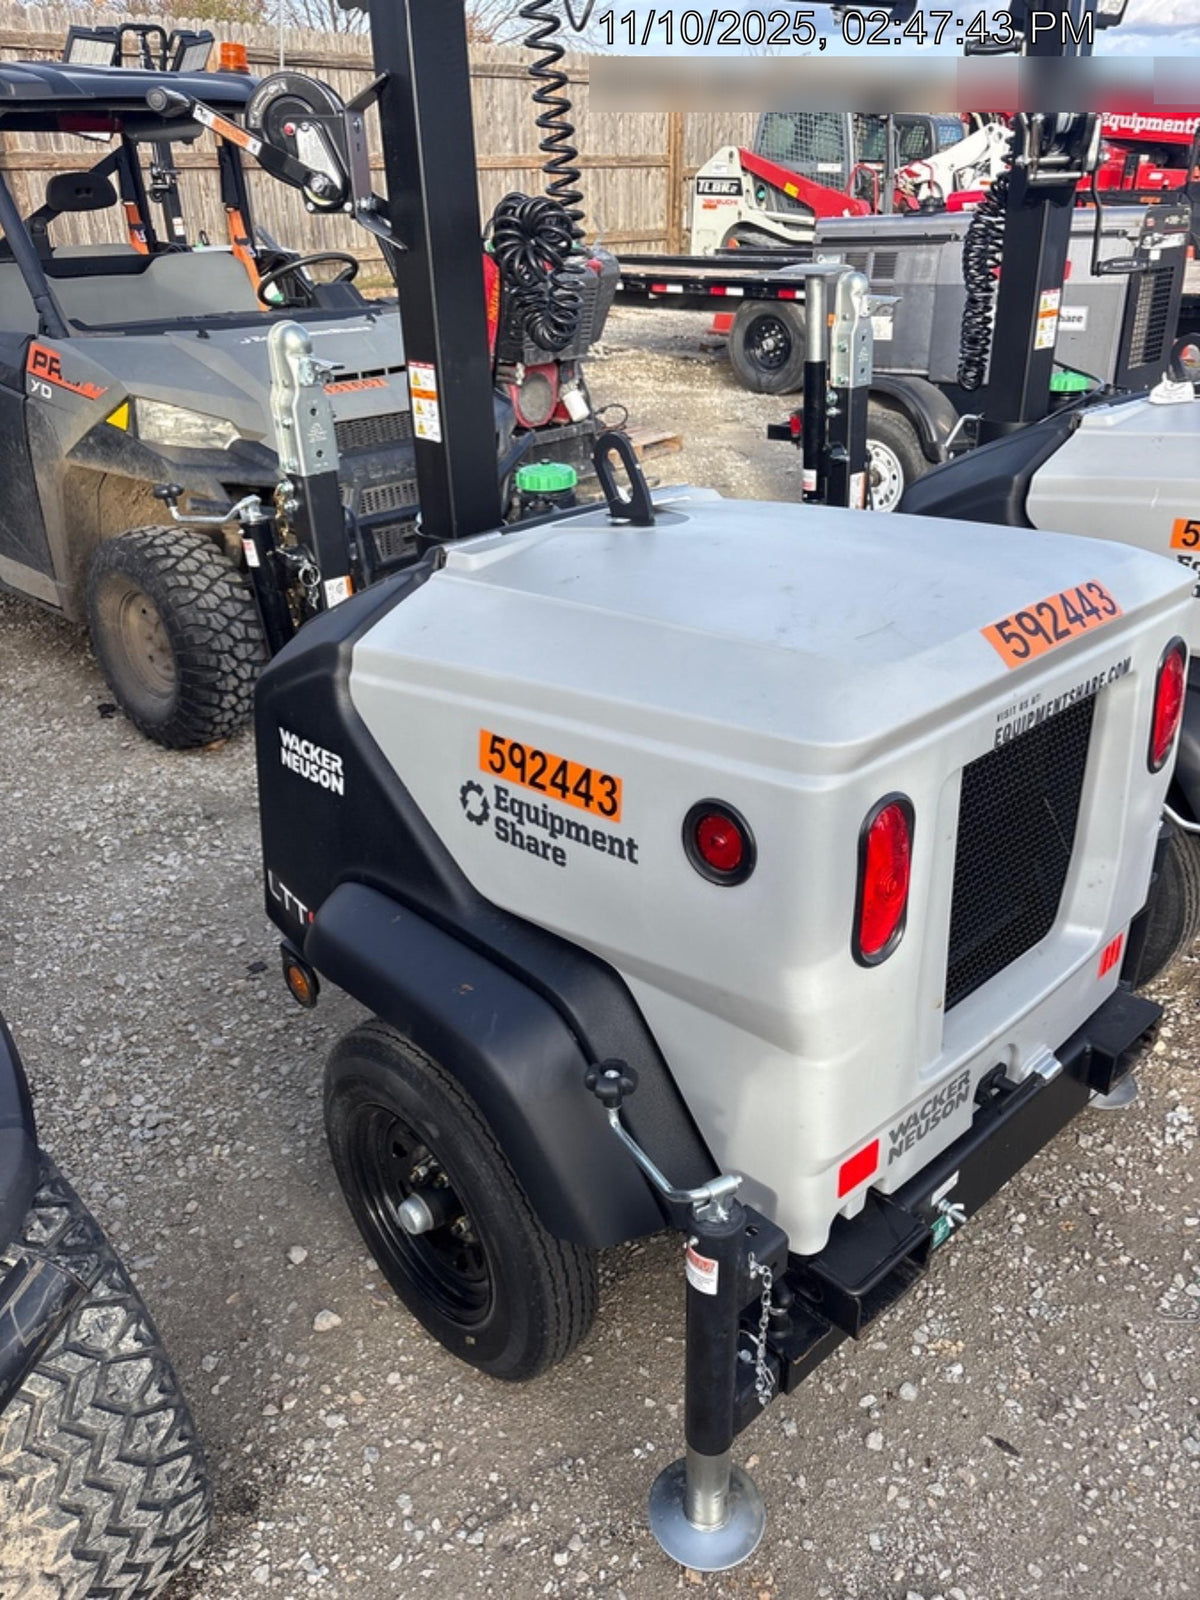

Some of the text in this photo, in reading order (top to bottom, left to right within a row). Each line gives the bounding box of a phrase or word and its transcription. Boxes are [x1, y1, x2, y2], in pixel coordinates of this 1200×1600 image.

[995, 582, 1117, 658] 592443
[994, 656, 1132, 748] EQUIPMENTSHARE.COM
[279, 726, 344, 776] WACKER
[281, 746, 344, 796] NEUSON
[489, 734, 618, 816] 592443
[494, 784, 639, 865] Equipment
[494, 815, 567, 867] Share
[268, 869, 313, 924] LTT
[887, 1084, 970, 1166] NEUSON
[888, 1069, 970, 1145] WACKER
